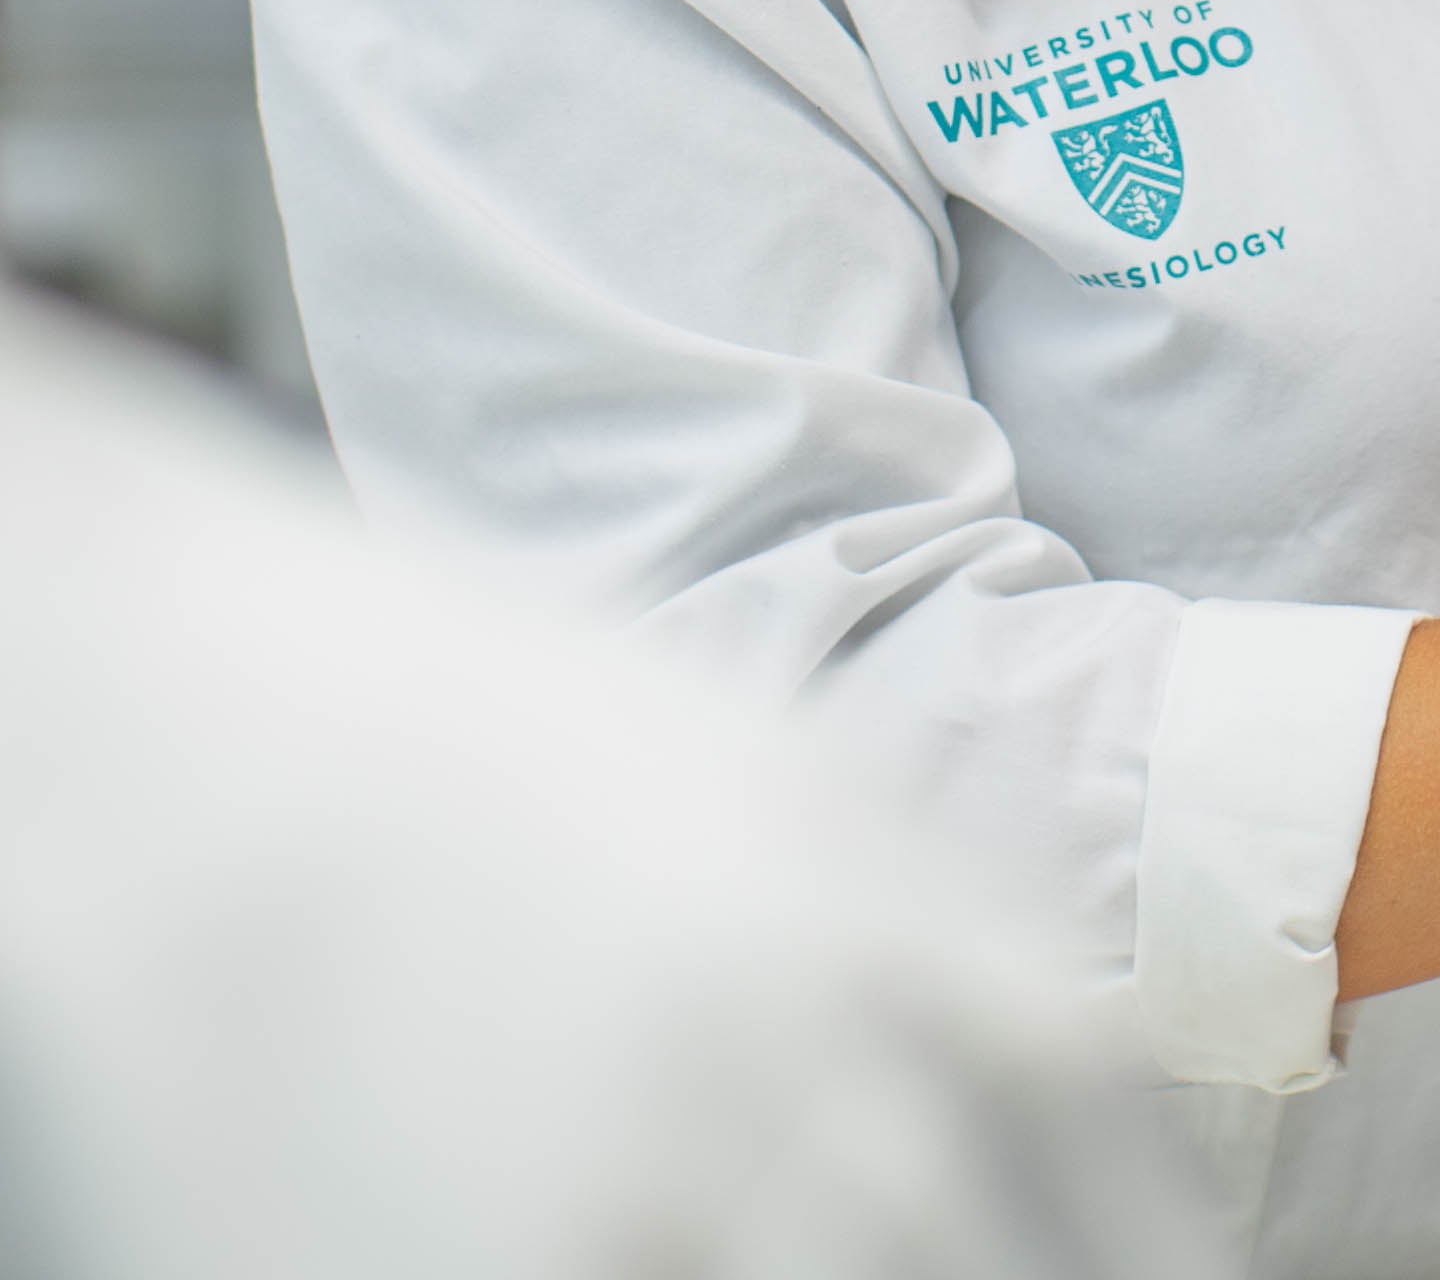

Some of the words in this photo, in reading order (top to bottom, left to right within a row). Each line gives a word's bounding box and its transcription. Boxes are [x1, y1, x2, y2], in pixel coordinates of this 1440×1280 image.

[927, 27, 1254, 142] WATERLOO
[944, 10, 1154, 85] UNIVERSITY
[1173, 0, 1213, 25] OF
[1069, 226, 1286, 289] INESIOLOGY
